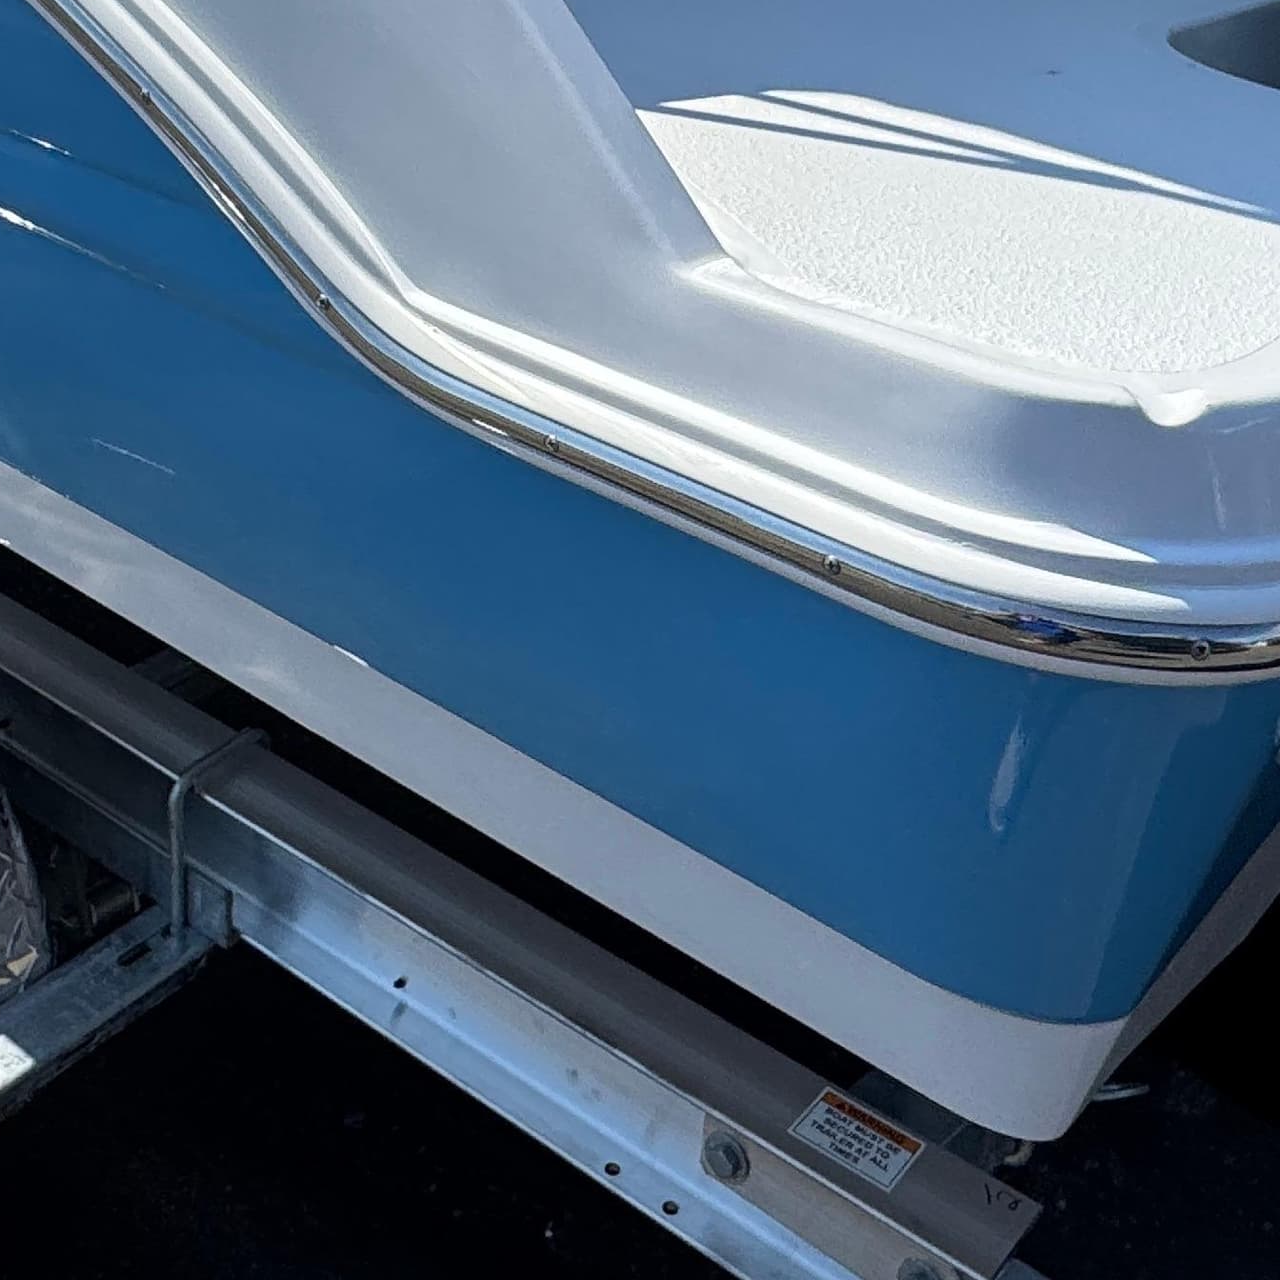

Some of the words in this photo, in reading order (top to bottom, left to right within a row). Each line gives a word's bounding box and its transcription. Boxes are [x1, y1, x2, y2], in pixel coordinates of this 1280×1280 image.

[823, 1117, 874, 1150] SECURED
[875, 1147, 890, 1160] TO
[824, 1107, 852, 1127] BOAT
[854, 1124, 885, 1145] MUST
[828, 1141, 860, 1164] TIMES
